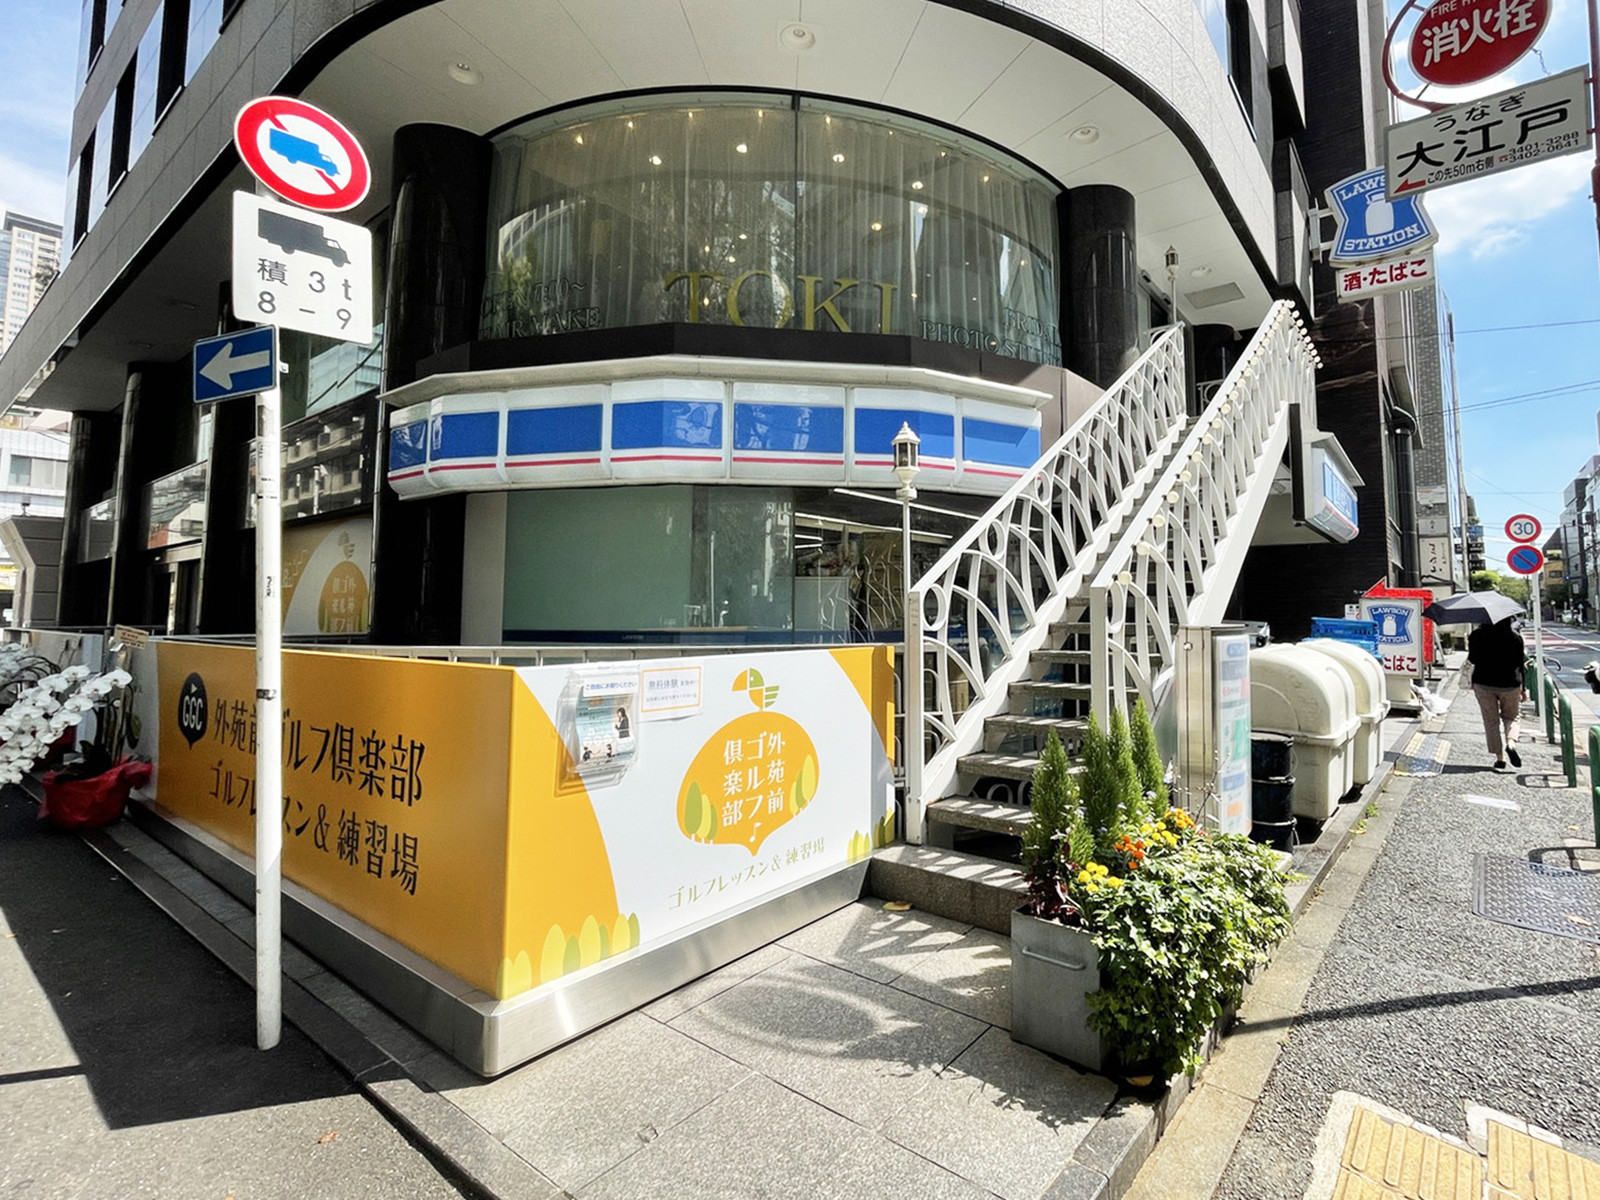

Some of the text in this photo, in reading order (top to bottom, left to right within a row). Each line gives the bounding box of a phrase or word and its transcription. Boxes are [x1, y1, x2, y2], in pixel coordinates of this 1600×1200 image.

[1430, 0, 1458, 19] FIRE
[1421, 0, 1538, 68] 消火栓
[1433, 91, 1526, 132] うなぎ
[1396, 98, 1572, 179] 大江戸
[1508, 131, 1580, 156] 3401-3288
[1508, 138, 1580, 164] 3402-0641
[1427, 154, 1496, 185] この先50m右側
[1339, 174, 1386, 201] LAWS
[1343, 223, 1422, 252] STATION
[257, 258, 289, 287] 積
[1343, 258, 1428, 292] 酒・たばこ
[663, 269, 899, 335] TOKI
[920, 319, 1000, 356] PHOTO
[1512, 521, 1535, 536] 30
[1378, 634, 1409, 644] TATION
[182, 693, 205, 731] GGC
[721, 738, 744, 828] 倶楽部
[745, 730, 767, 820] ゴルフ
[766, 731, 786, 815] 外苑前
